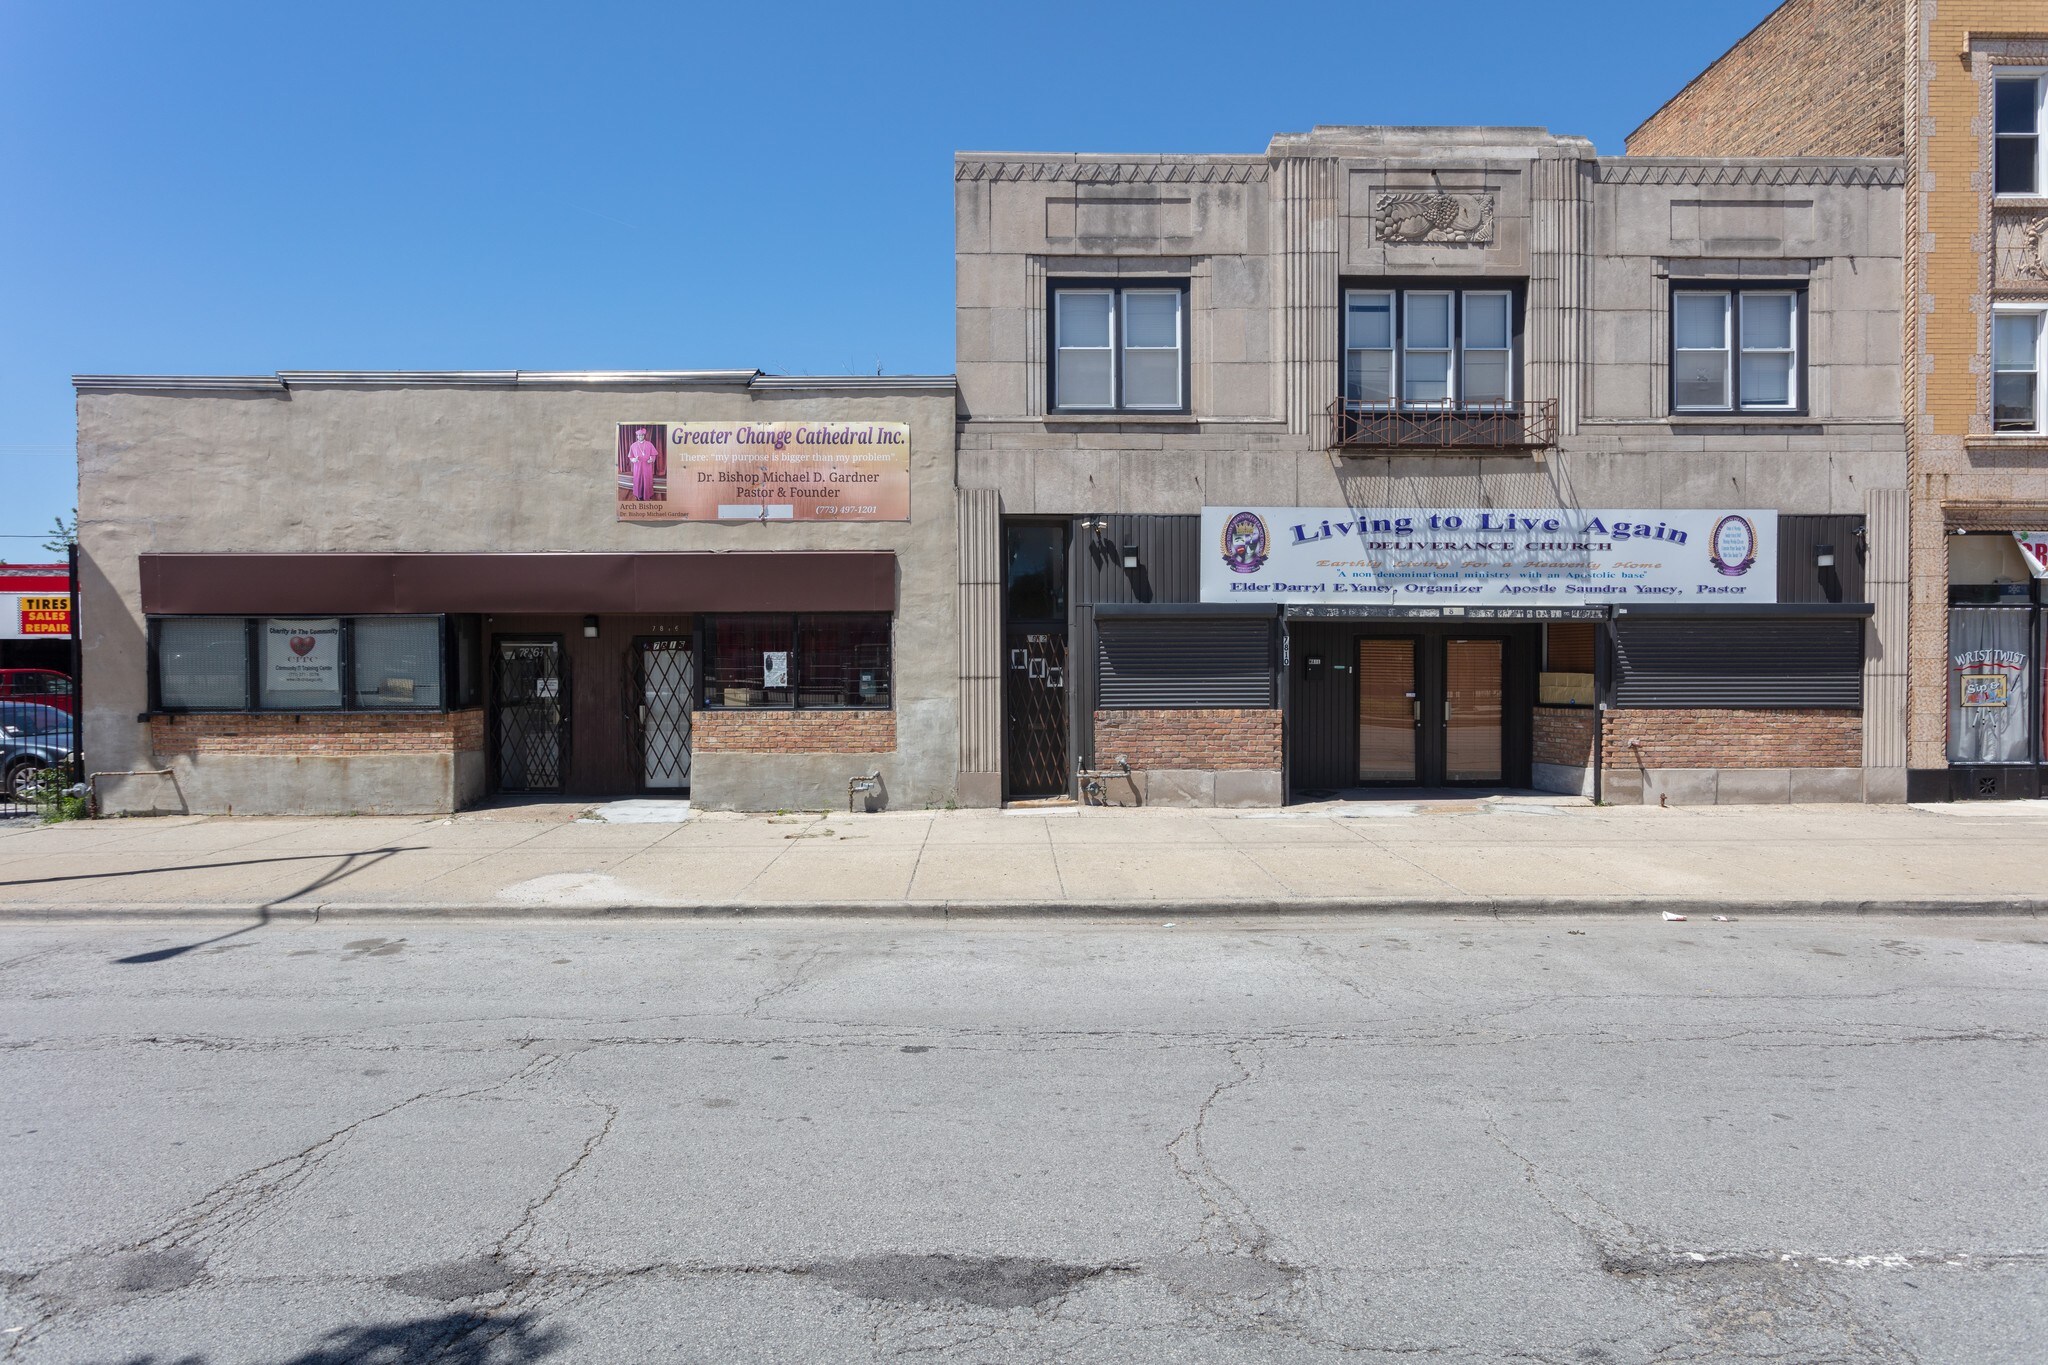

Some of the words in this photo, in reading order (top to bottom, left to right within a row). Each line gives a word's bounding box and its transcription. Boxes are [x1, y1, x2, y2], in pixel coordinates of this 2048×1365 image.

[672, 427, 732, 444] Greater
[736, 427, 792, 450] Change
[796, 427, 873, 445] Cathedral
[876, 427, 905, 445] Inc.
[731, 454, 769, 464] purpose
[771, 453, 779, 461] is
[781, 453, 809, 464] bigger
[812, 453, 833, 461] than
[836, 455, 850, 464] my
[697, 472, 715, 483] Dr.
[719, 471, 760, 485] Bishop
[762, 472, 810, 483] Michael
[813, 472, 826, 483] D.
[829, 472, 880, 483] Gardner
[736, 487, 774, 498] Pastor
[777, 487, 787, 498] &
[790, 487, 840, 498] Founder
[639, 503, 663, 511] Bishop
[815, 505, 838, 515] (773)
[840, 505, 877, 514] 497-1201
[1291, 515, 1413, 546] Living
[1428, 513, 1463, 531] to
[1477, 513, 1560, 532] Live
[1582, 516, 1689, 545] Again
[1368, 541, 1514, 551] DELIVERANCE
[1525, 542, 1612, 551] CHURCH
[1316, 559, 1383, 569] Earthly
[1393, 559, 1449, 569] Living
[1460, 560, 1490, 569] For
[1523, 561, 1600, 570] Heavenly
[1611, 561, 1663, 569] Home
[1464, 571, 1511, 580] ministry
[1566, 571, 1616, 580] Apostolic
[1230, 582, 1271, 592] Elder
[1272, 582, 1326, 593] Darryl
[1404, 583, 1483, 595] Organizer
[1500, 584, 1557, 595] Apostle
[1565, 584, 1627, 594] Saundra
[1634, 584, 1683, 596] Yancy,
[1696, 584, 1747, 595] Pastor
[27, 599, 68, 610] TIRES
[28, 612, 66, 621] SALES
[25, 623, 69, 632] REPAIR
[1954, 648, 1992, 665] WRIST
[1993, 649, 2026, 664] TWIST
[1967, 684, 1987, 693] Sip
[1990, 681, 2000, 690] &
